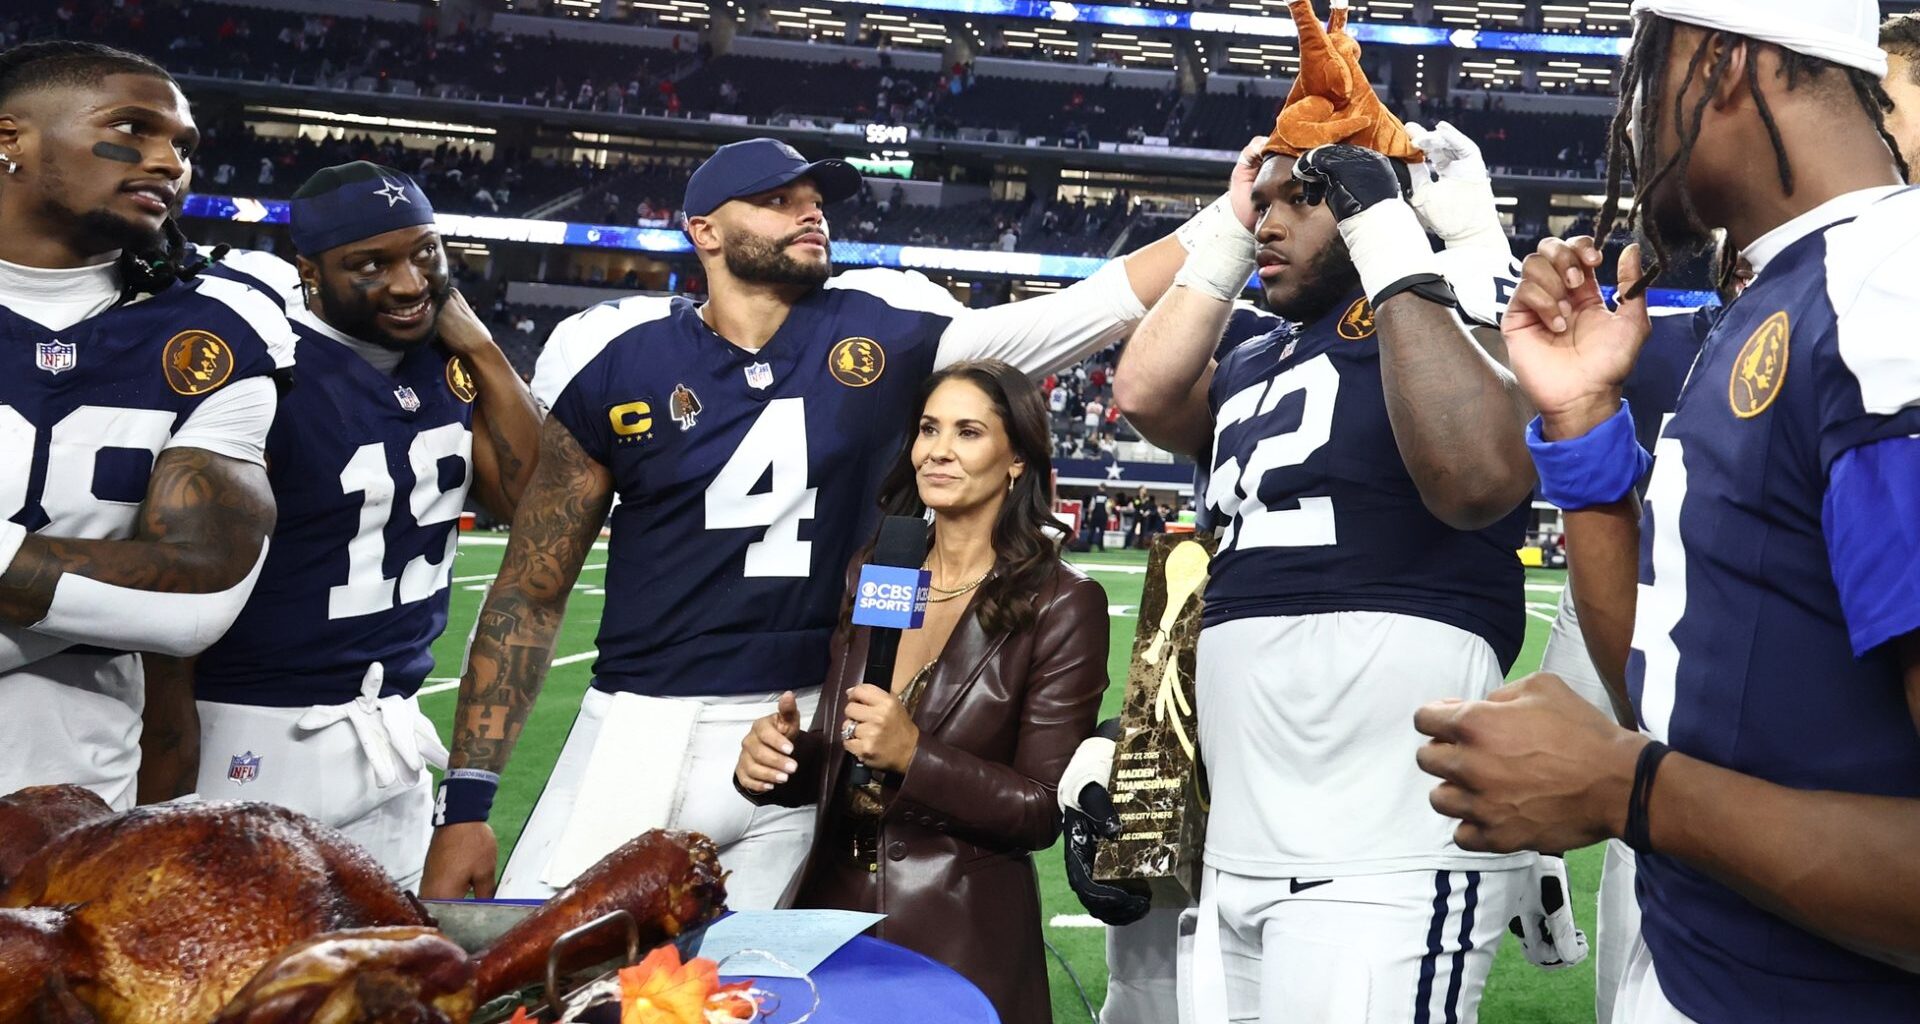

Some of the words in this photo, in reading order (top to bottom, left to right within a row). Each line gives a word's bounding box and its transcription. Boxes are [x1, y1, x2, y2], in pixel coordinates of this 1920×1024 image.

[43, 353, 71, 367] NFL
[609, 401, 653, 436] C
[1205, 352, 1341, 557] 52
[704, 396, 819, 578] 4
[328, 421, 474, 620] 19
[877, 583, 913, 601] CBS
[859, 597, 911, 612] SPORTS
[1120, 753, 1133, 761] NOV
[1143, 751, 1160, 760] 2025
[233, 766, 254, 779] NFL
[1117, 768, 1155, 779] MADDEN
[1115, 778, 1181, 791] THANKSGIVING
[434, 784, 448, 826] 4
[1112, 793, 1135, 803] MVP
[1135, 812, 1151, 820] CITY
[1150, 811, 1173, 820] CHIEFS
[1131, 831, 1164, 840] COWBOYS
